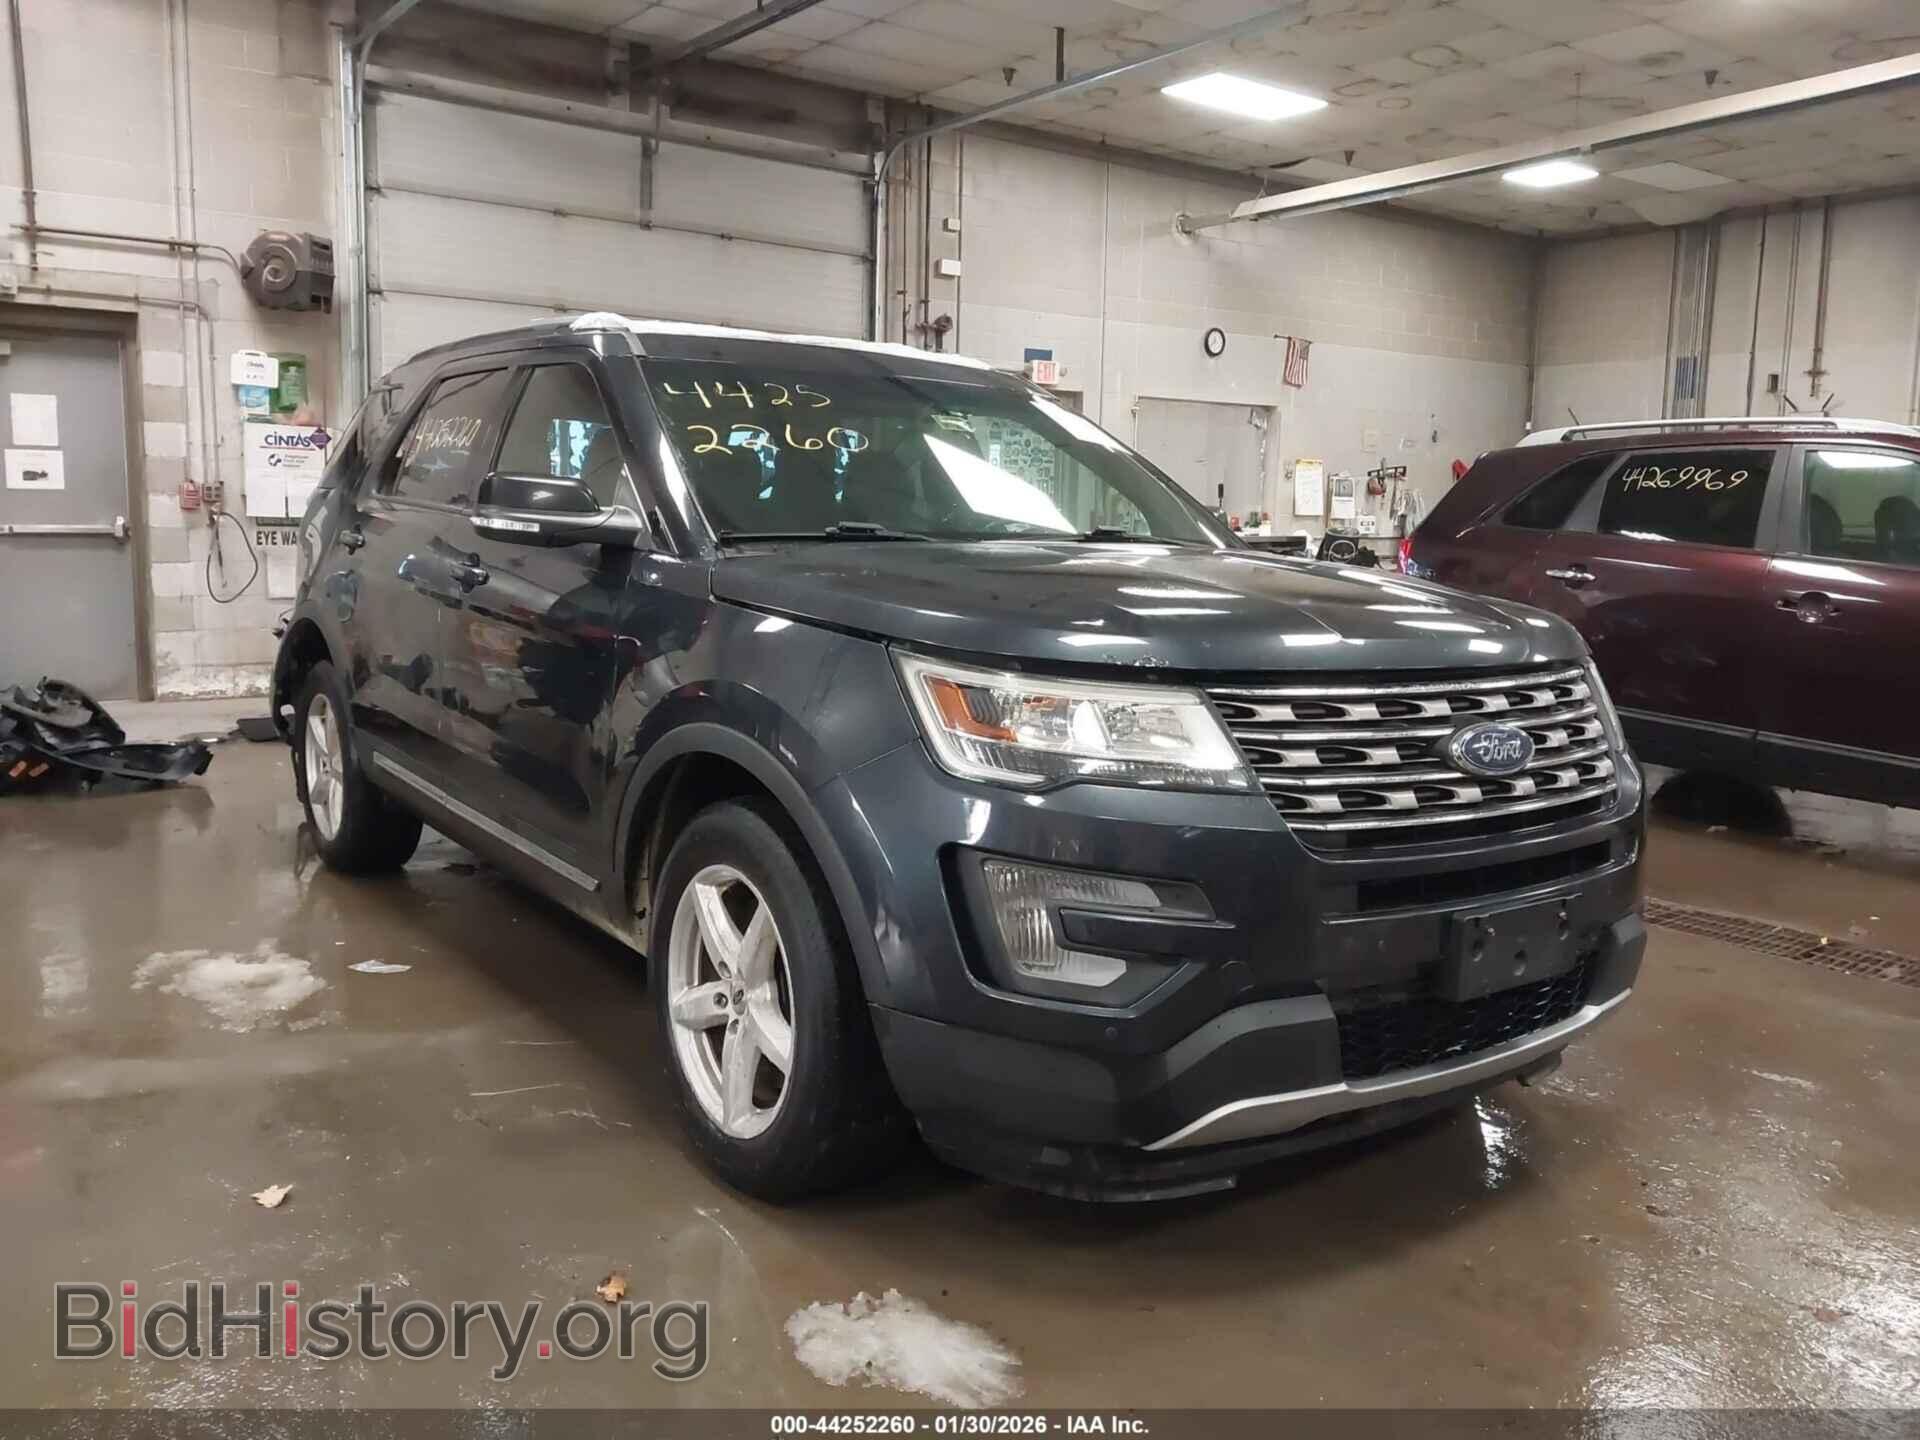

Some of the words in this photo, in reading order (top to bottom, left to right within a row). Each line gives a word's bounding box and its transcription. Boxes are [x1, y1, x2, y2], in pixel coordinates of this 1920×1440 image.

[664, 381, 831, 408] 4425
[687, 424, 869, 455] 2260
[1622, 466, 1748, 492] 44269969
[256, 530, 277, 545] EYE
[1472, 732, 1521, 763] Ford
